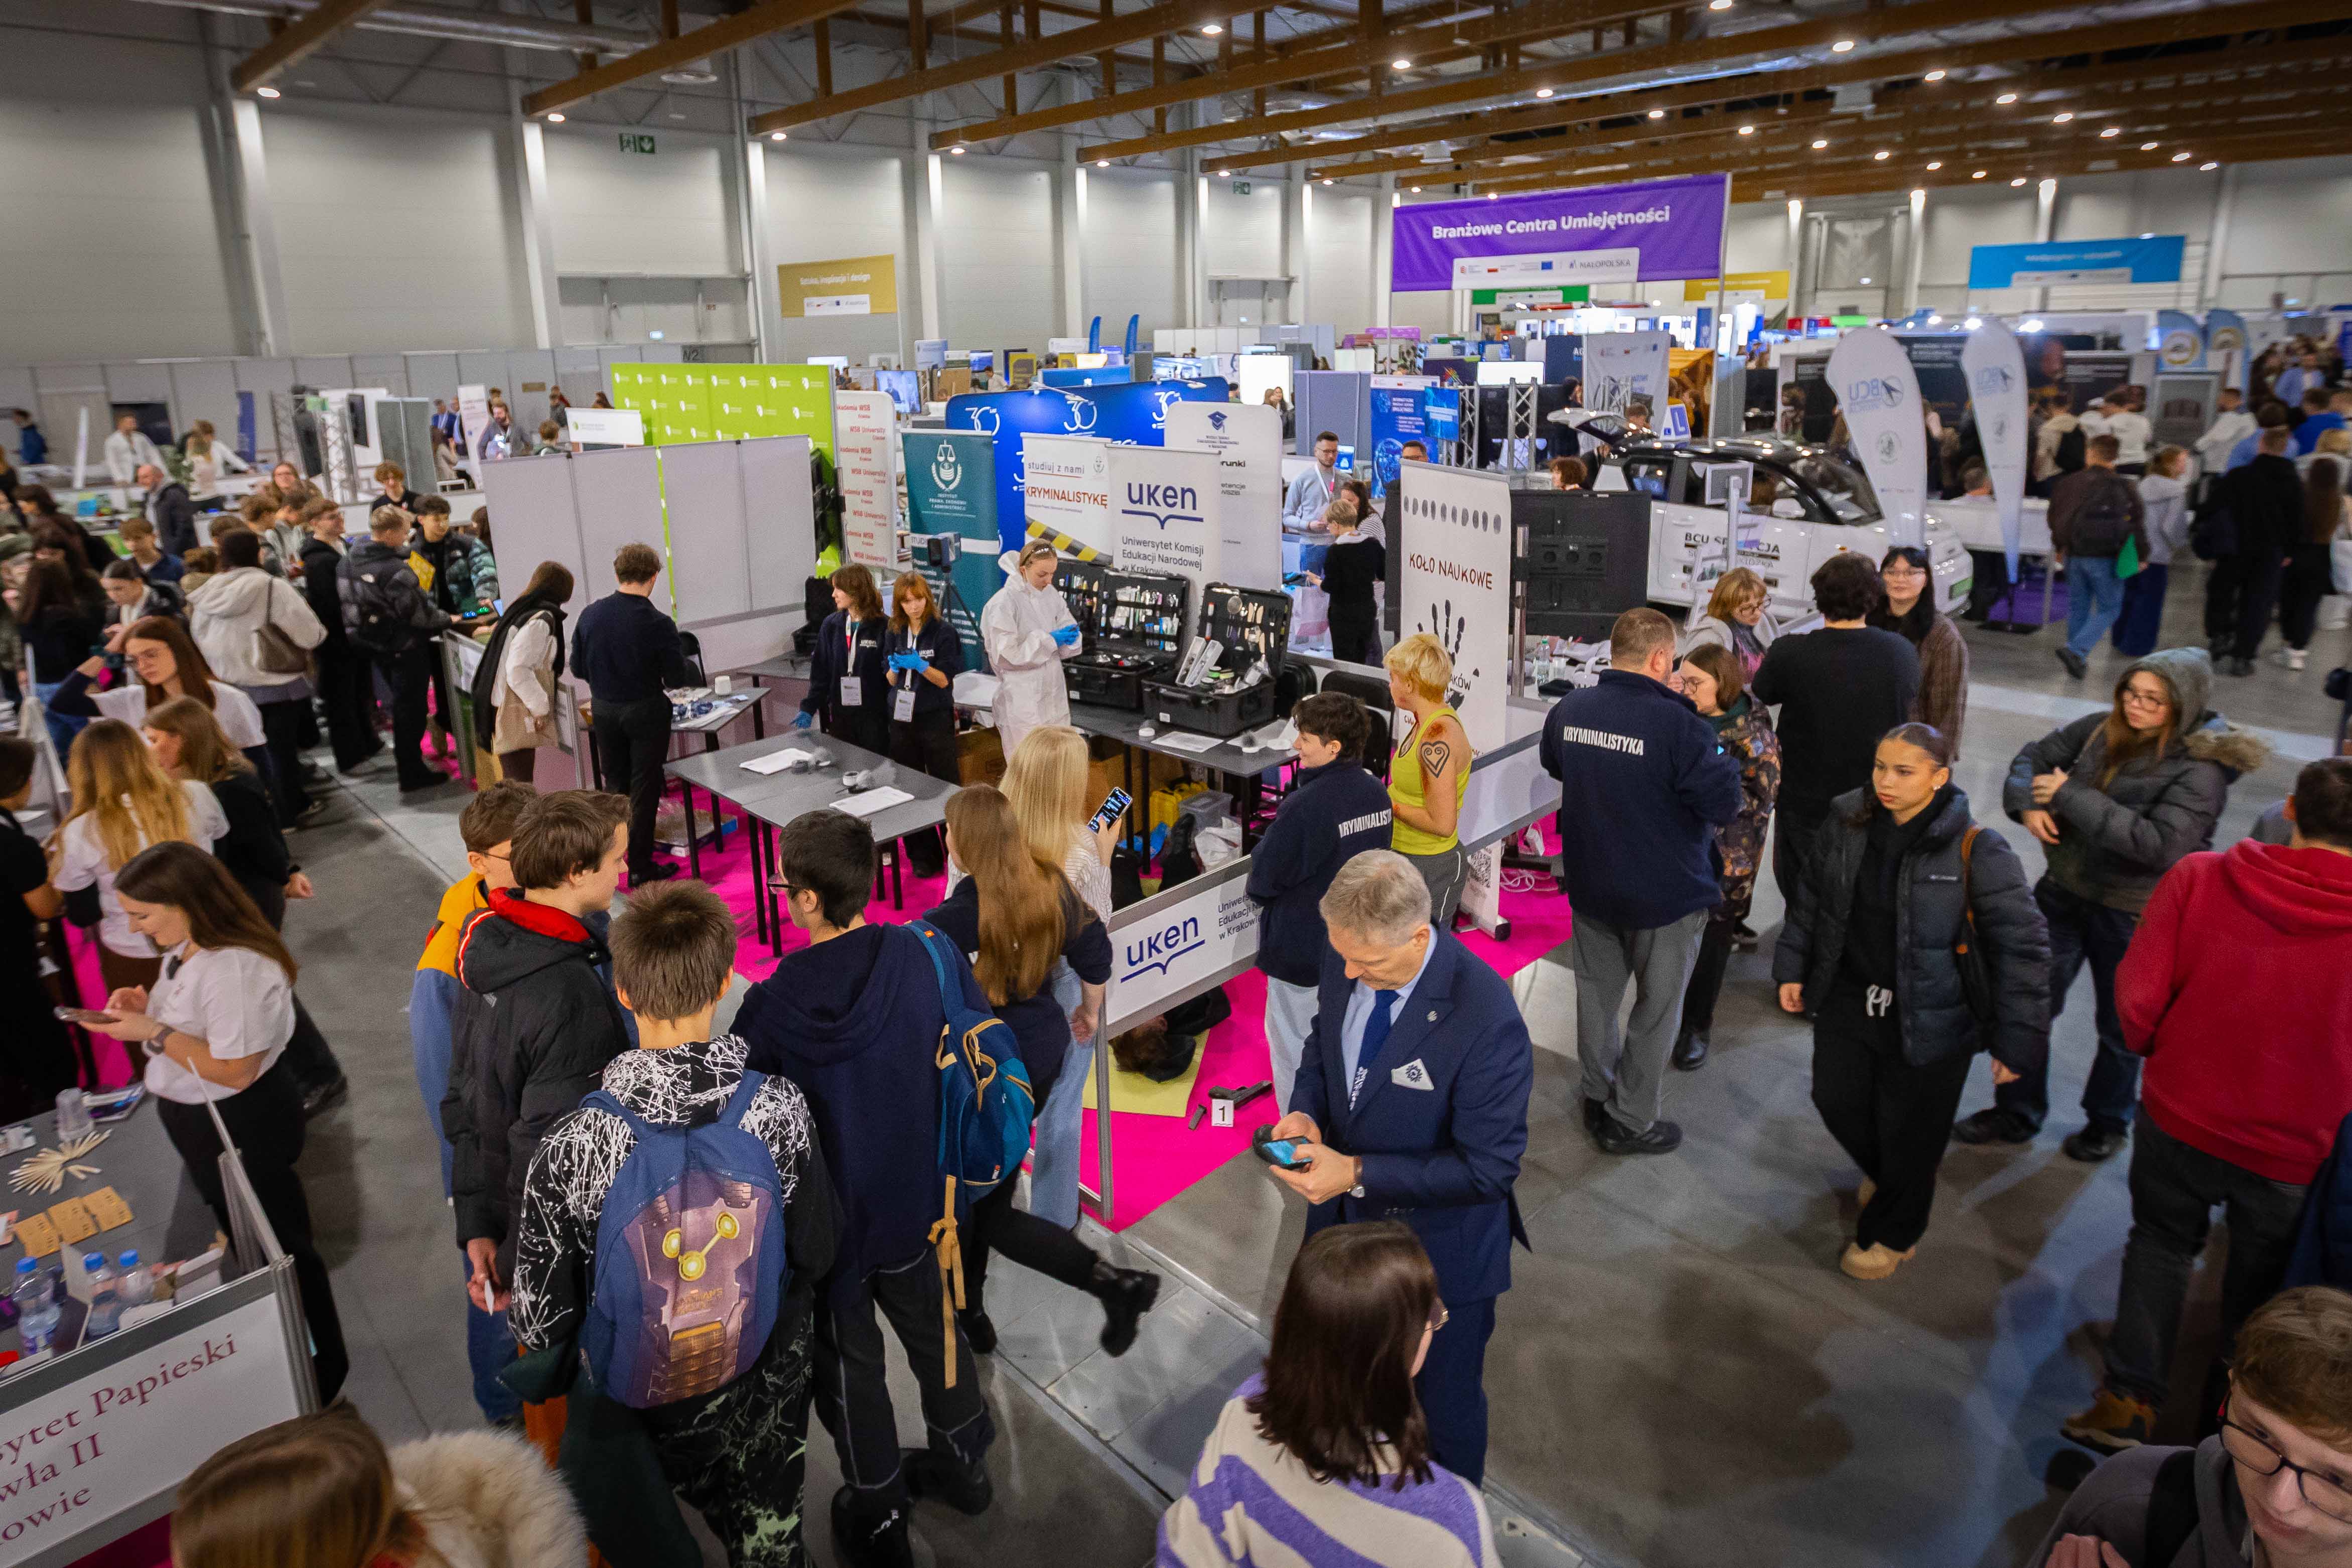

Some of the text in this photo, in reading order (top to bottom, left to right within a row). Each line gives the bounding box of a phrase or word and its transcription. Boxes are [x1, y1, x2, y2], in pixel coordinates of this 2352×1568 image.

[1432, 205, 1671, 239] Branżowe Centra Umiejętności
[1579, 259, 1631, 269] MAŁOPOLSKA
[1063, 400, 1097, 432] 30
[1674, 411, 1686, 432] L
[860, 446, 872, 454] WSB
[863, 468, 887, 477] University
[1028, 461, 1055, 473] studiuj
[1064, 465, 1084, 474] nami
[1026, 486, 1108, 509] KRYMINALISTYKĘ
[1128, 482, 1197, 511] uken
[864, 511, 887, 520] University
[863, 531, 874, 539] WSB
[1685, 532, 1709, 544] BCU
[1122, 536, 1204, 556] Uniwersytet Komisji
[865, 553, 888, 563] University
[1122, 549, 1202, 571] Edukacji Narodowej
[1409, 553, 1492, 590] KOŁO NAUKOWE
[1450, 673, 1471, 690] AKÓW
[1564, 726, 1644, 756] KRYMINALISTYKA
[1218, 894, 1249, 913] Uniwers
[1219, 914, 1262, 940] w Krakowie
[1127, 916, 1199, 967] uken
[1218, 1105, 1225, 1122] 1
[0, 1333, 237, 1465] ytet Papieski
[0, 1431, 105, 1502] wła II
[1, 1487, 92, 1541] owie
